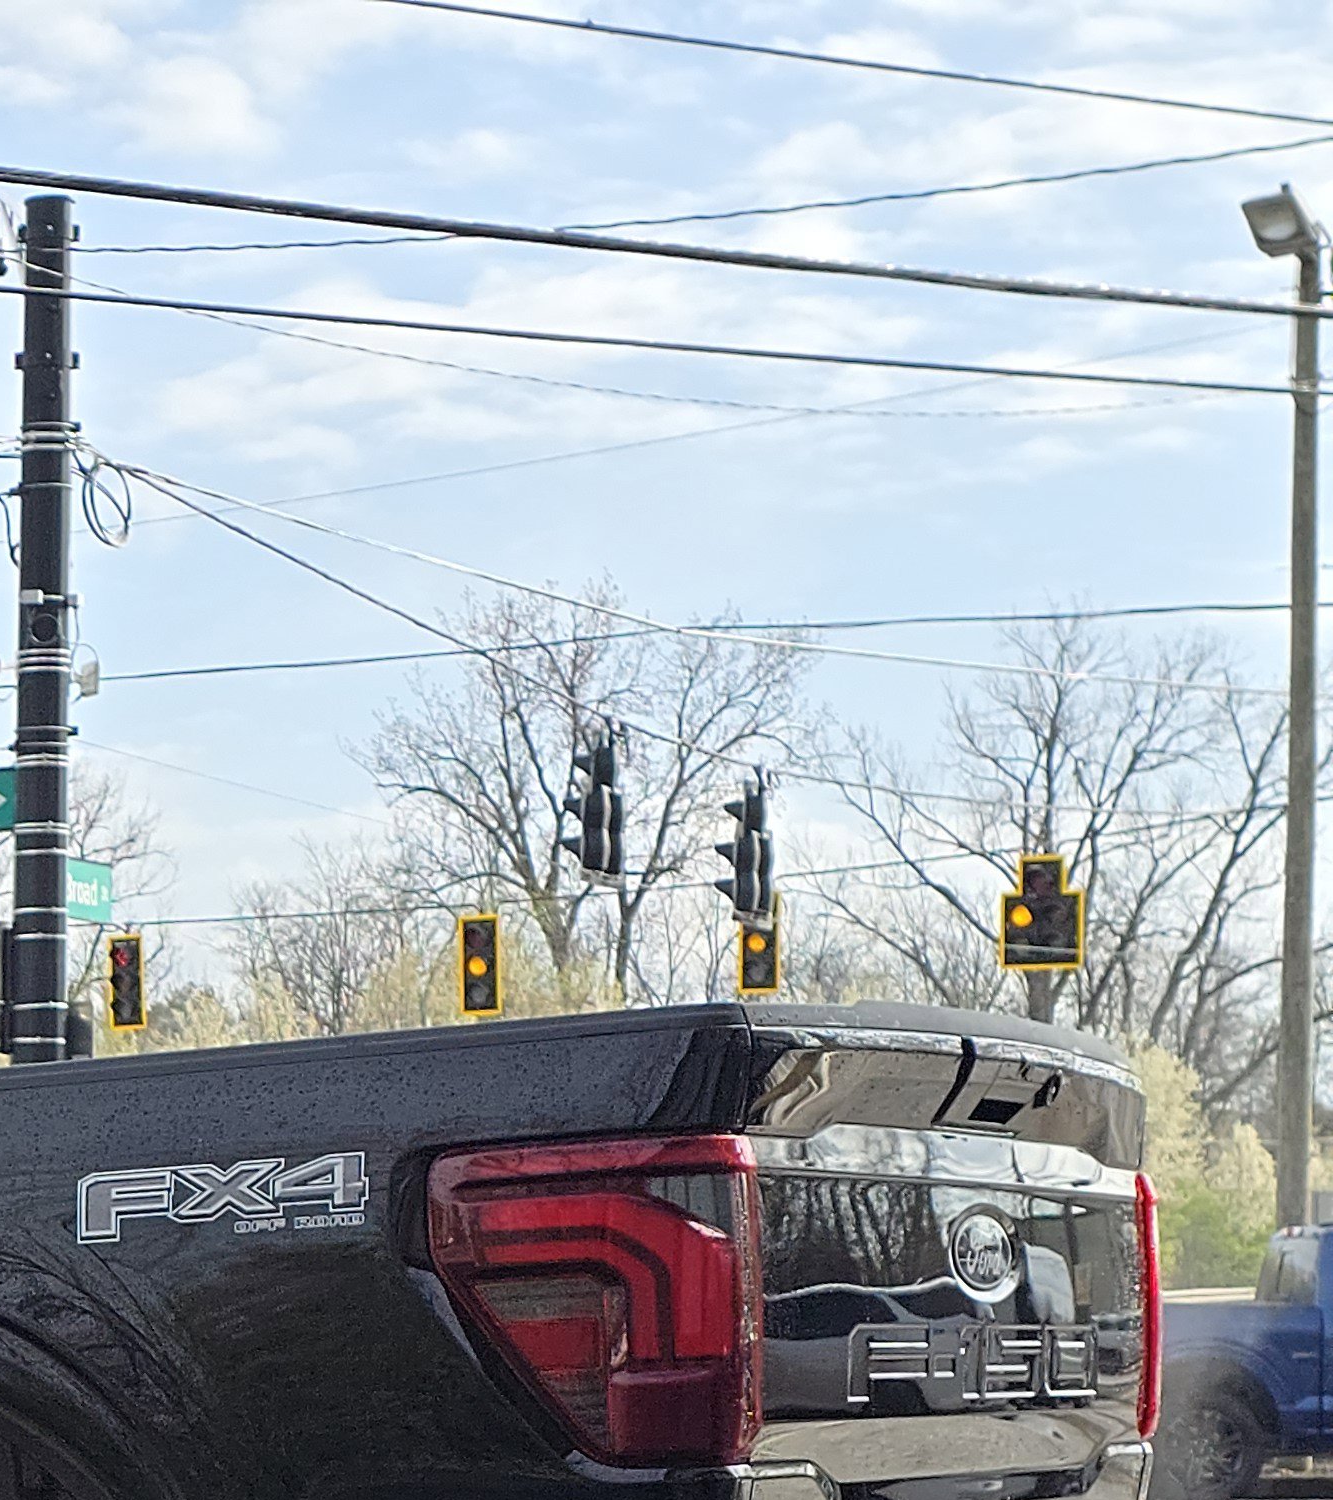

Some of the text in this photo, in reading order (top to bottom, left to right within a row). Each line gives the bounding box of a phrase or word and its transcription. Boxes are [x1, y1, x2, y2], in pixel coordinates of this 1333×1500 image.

[77, 1151, 370, 1245] FX4
[234, 1213, 366, 1234] OFF ROAD
[846, 1323, 1099, 1403] F-150
